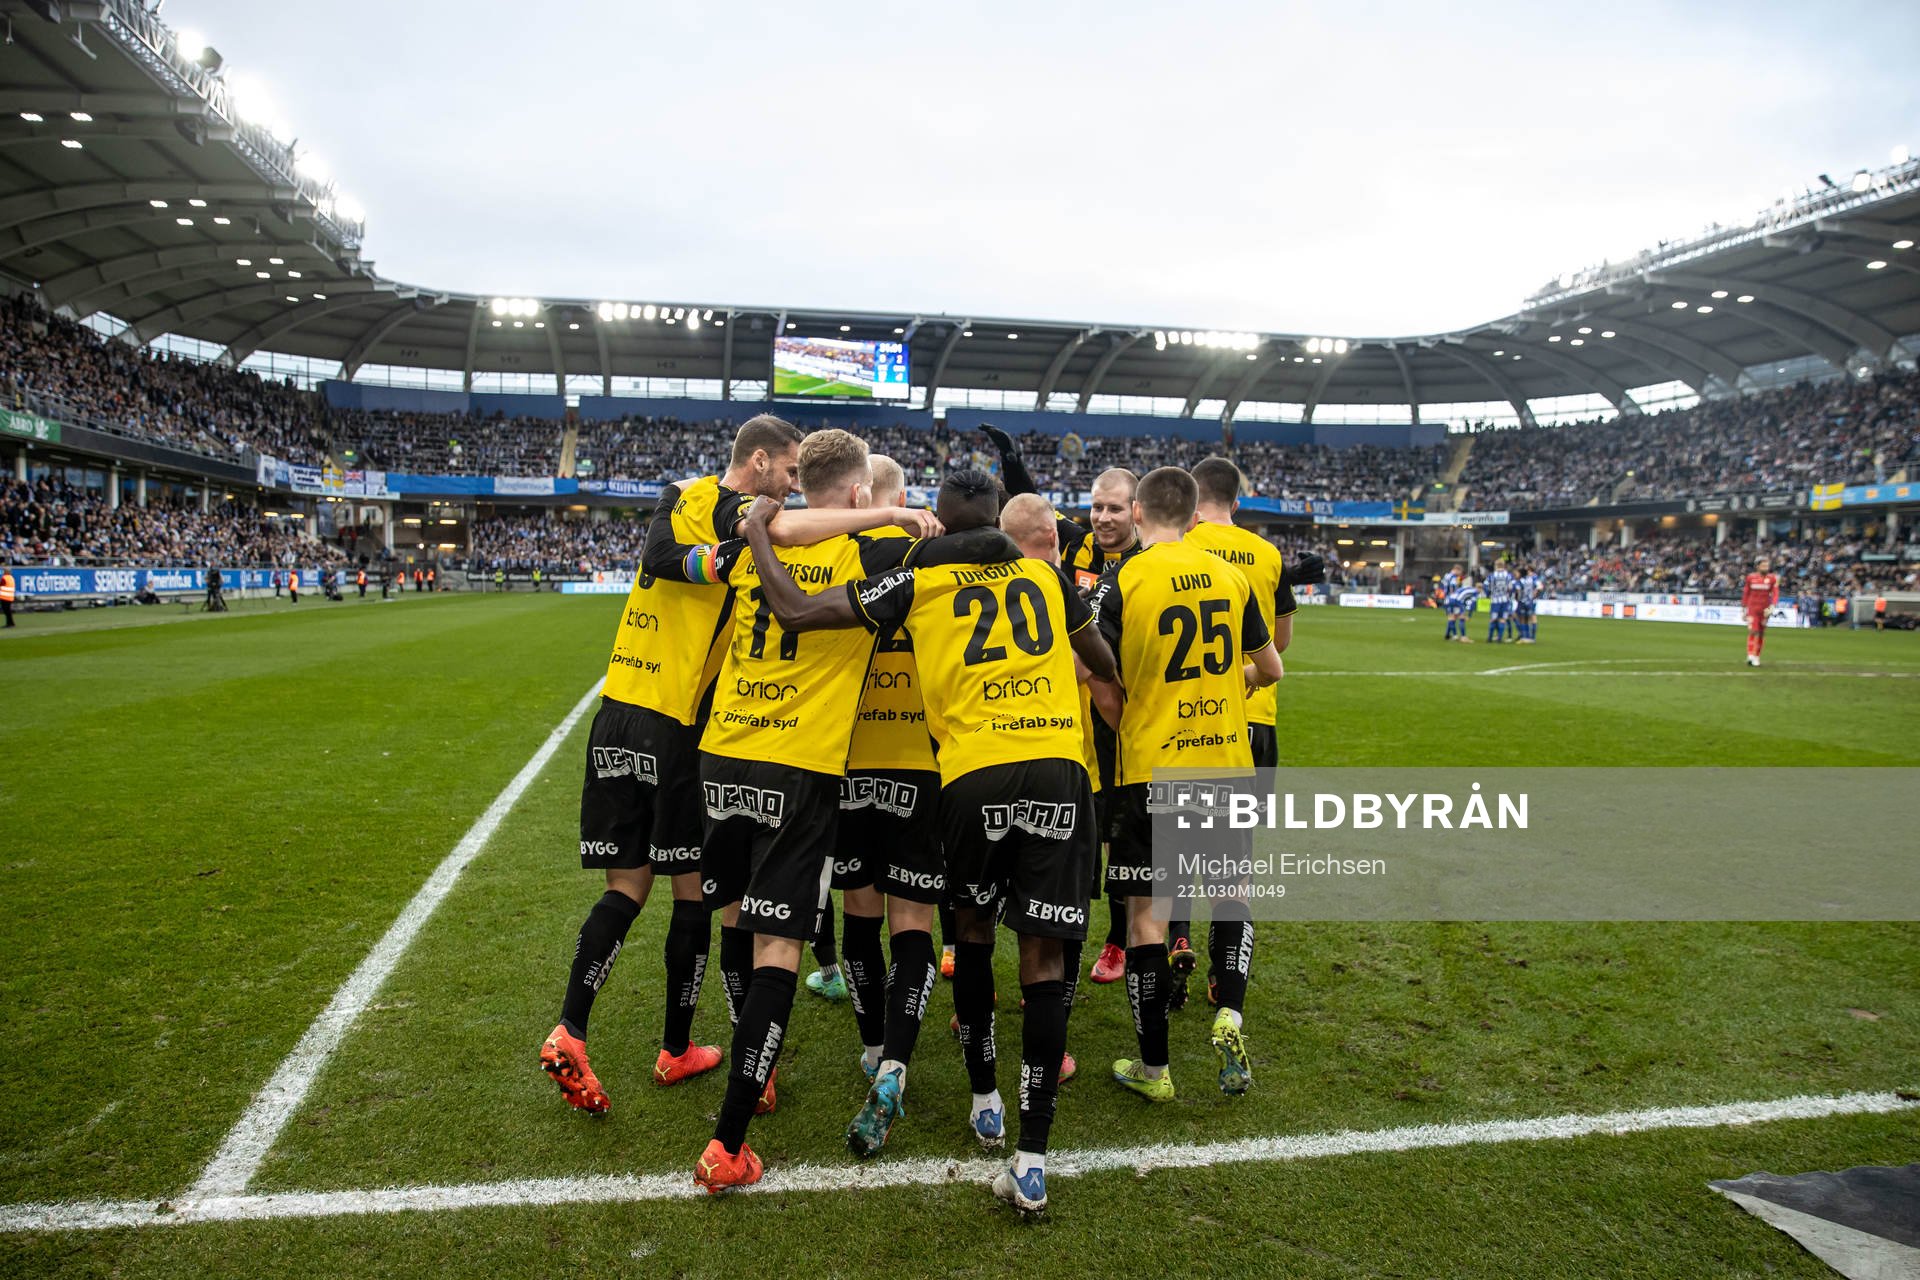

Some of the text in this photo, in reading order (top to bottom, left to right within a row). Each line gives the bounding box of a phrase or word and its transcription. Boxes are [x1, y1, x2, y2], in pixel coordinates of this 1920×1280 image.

[20, 571, 82, 592] IFK GÖTEBORG
[94, 570, 137, 592] SERNEKE
[859, 568, 914, 606] stadium
[1170, 573, 1213, 593] LUND
[953, 577, 1054, 667] 20
[1158, 599, 1234, 684] 25
[983, 675, 1052, 701] brion
[857, 708, 925, 724] refab syd
[1178, 695, 1229, 719] brion
[723, 710, 799, 731] prefab syd
[1050, 715, 1074, 730] syd
[1177, 733, 1223, 751] prefab
[703, 781, 785, 820] DEMO
[1226, 945, 1237, 971] TYRES
[583, 960, 602, 987] TYRES
[1142, 970, 1157, 1002] TYRES
[904, 987, 920, 1017] TYRES
[742, 1046, 759, 1078] TYRES
[755, 1021, 784, 1085] MAXXIS
